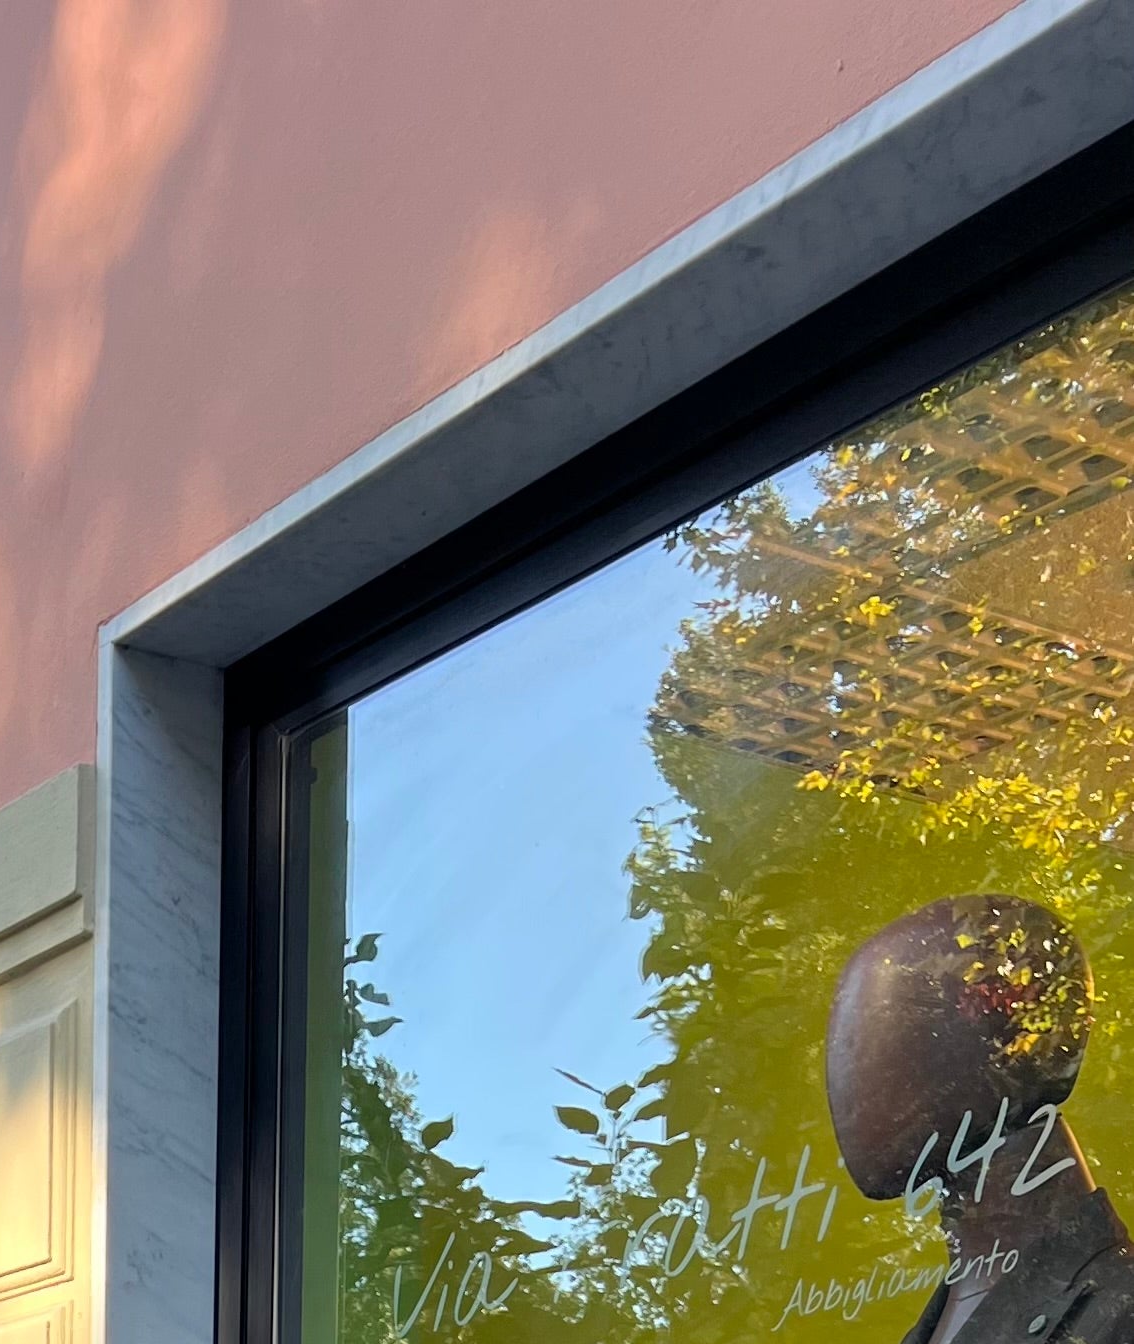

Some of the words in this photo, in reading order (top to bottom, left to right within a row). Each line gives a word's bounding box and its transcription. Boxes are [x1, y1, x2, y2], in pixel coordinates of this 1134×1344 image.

[393, 1232, 518, 1338] Via
[904, 1096, 1076, 1218] 642
[771, 1238, 1019, 1333] Abbigliamento
